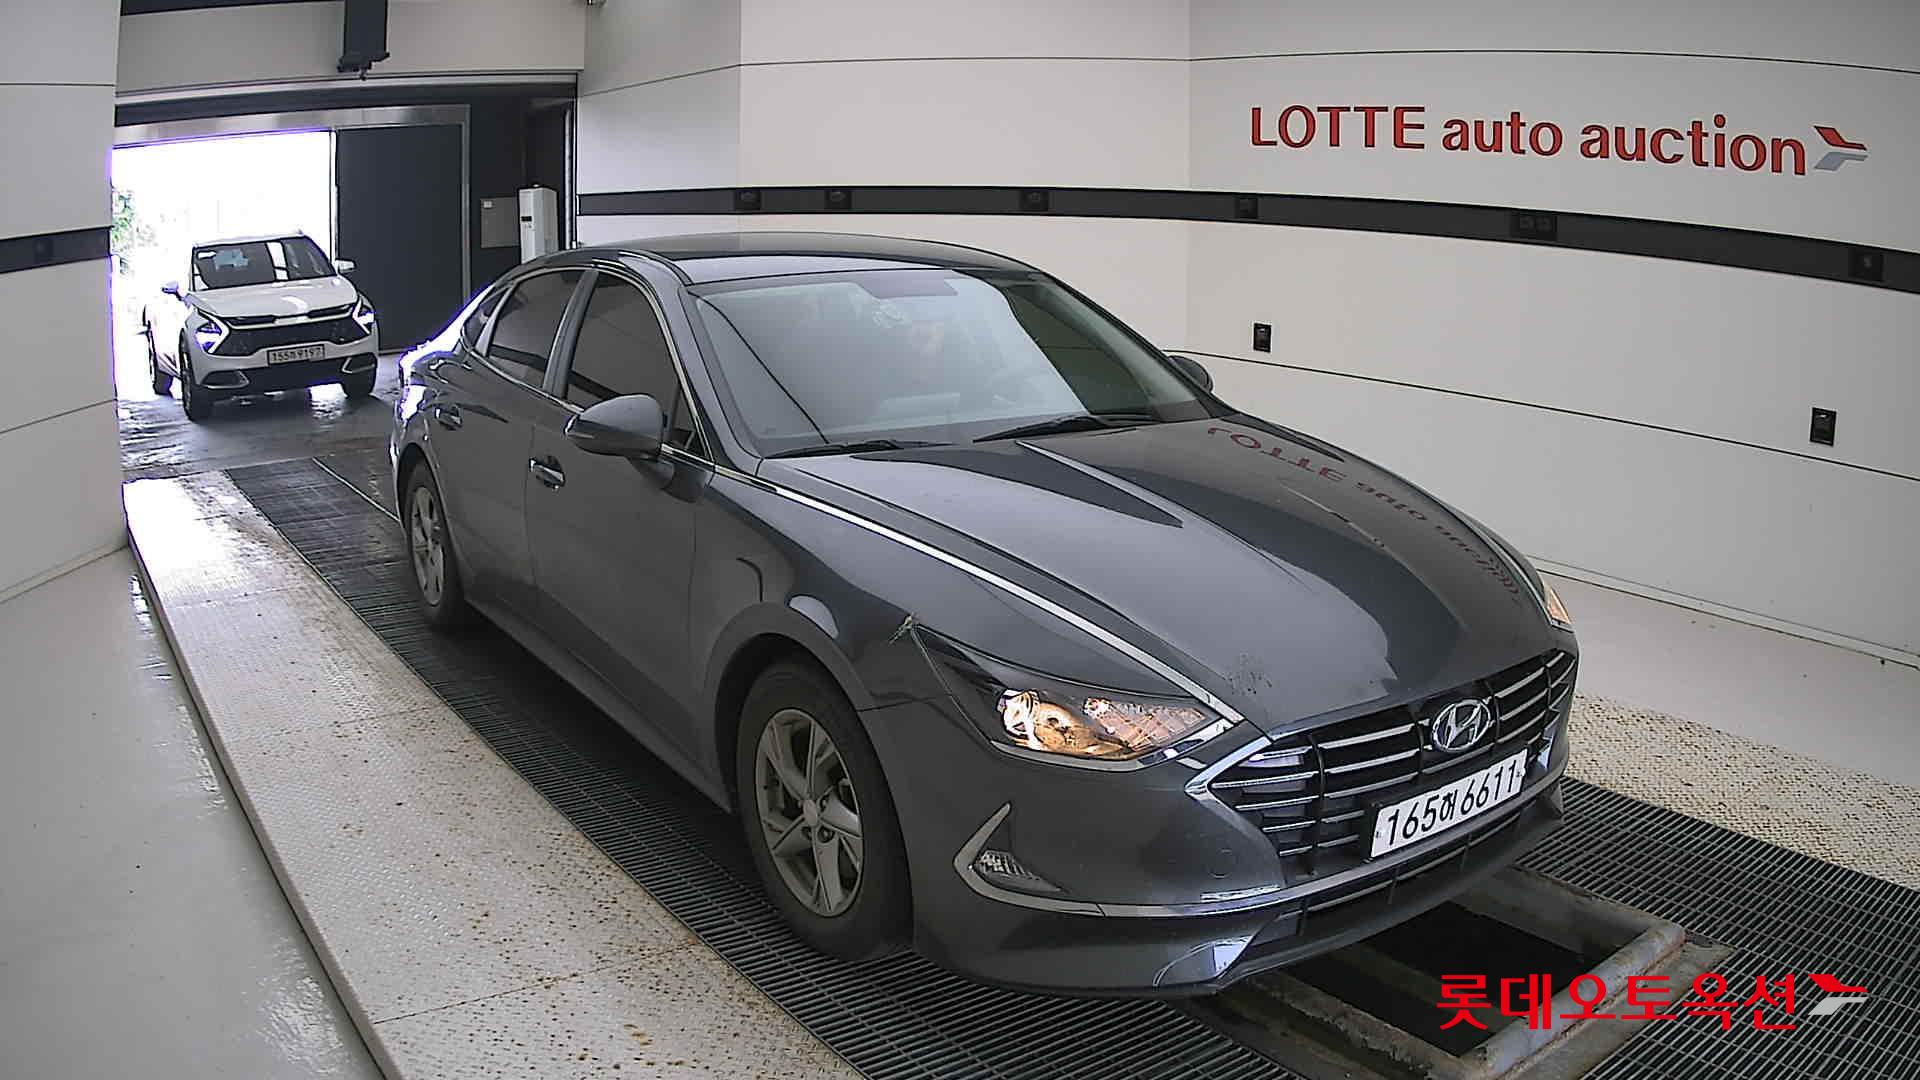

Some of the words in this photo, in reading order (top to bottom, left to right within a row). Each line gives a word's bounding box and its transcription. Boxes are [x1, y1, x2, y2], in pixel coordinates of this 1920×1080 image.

[1252, 106, 1426, 149] LOTTE
[1443, 112, 1562, 157] auto
[1580, 115, 1807, 176] auction
[1387, 759, 1517, 846] 165허6611
